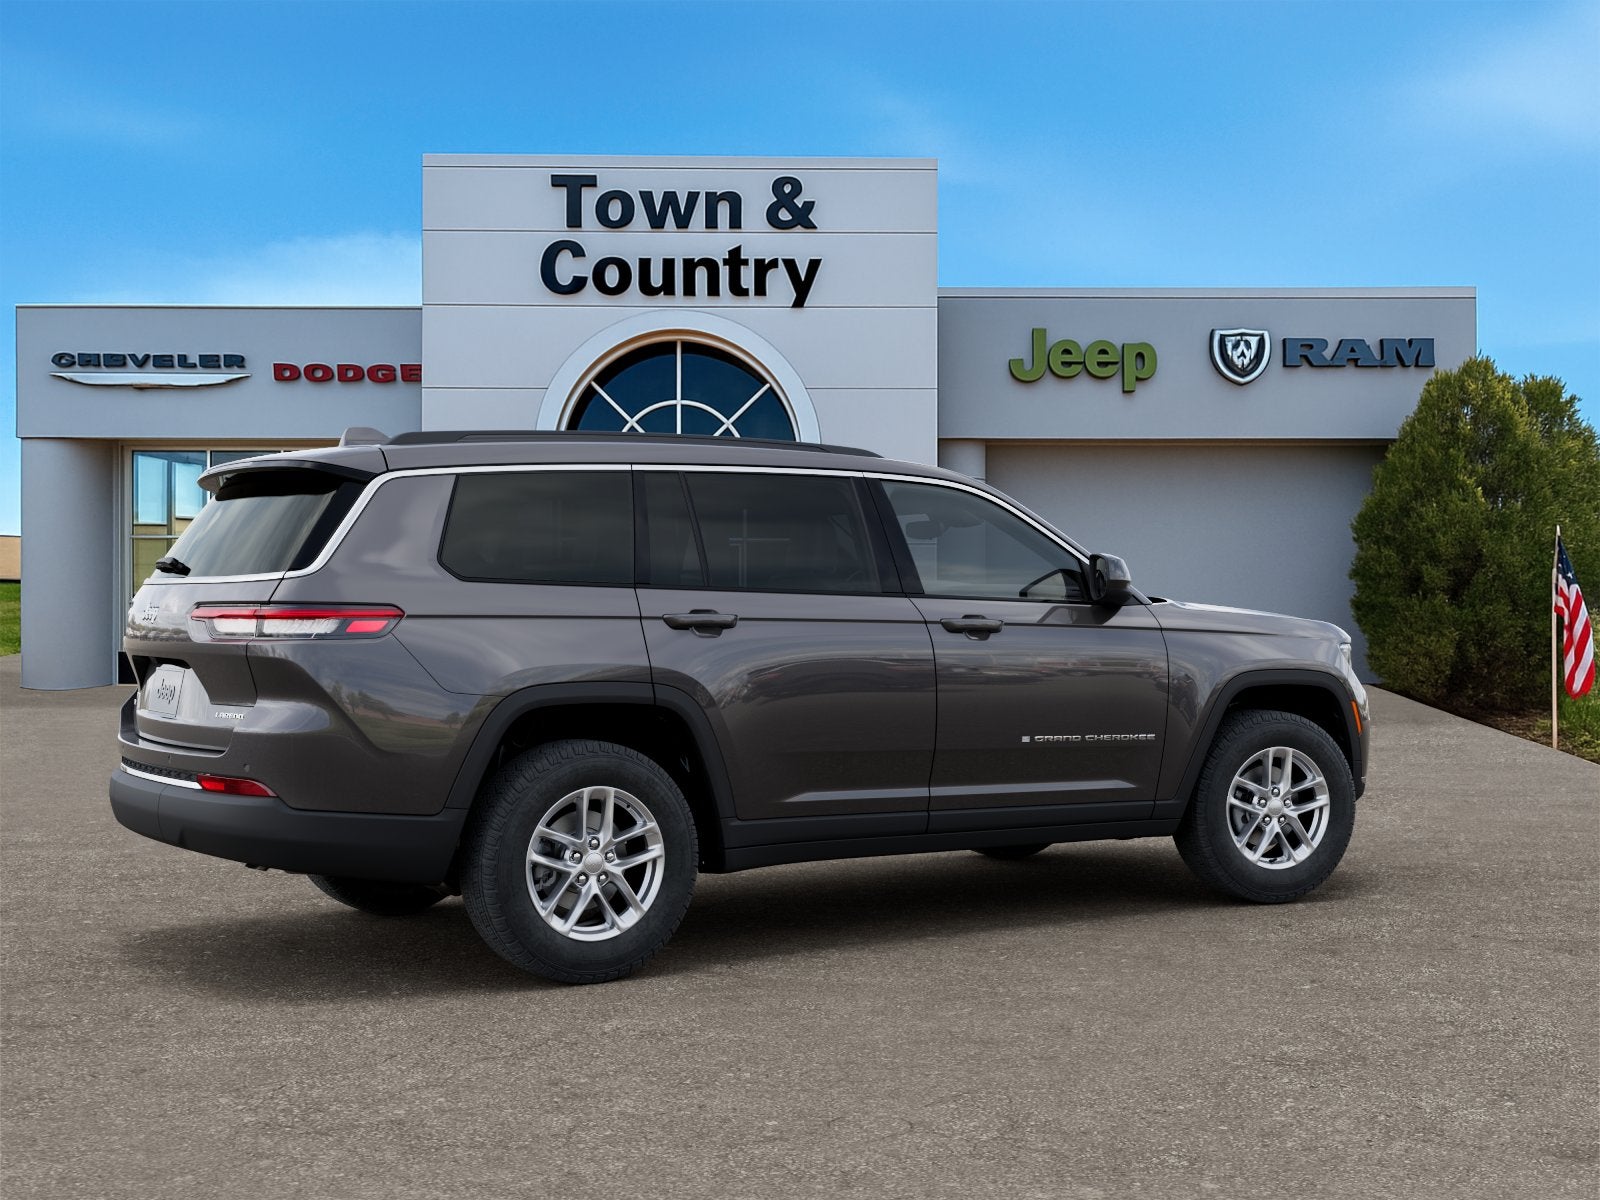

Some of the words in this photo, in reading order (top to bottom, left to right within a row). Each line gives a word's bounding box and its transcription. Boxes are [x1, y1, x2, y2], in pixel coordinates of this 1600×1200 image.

[550, 174, 743, 229] Town
[765, 176, 818, 230] &
[540, 239, 822, 308] Country
[272, 363, 422, 383] DODGE
[1009, 328, 1157, 393] Jeep
[1282, 337, 1435, 367] RAM
